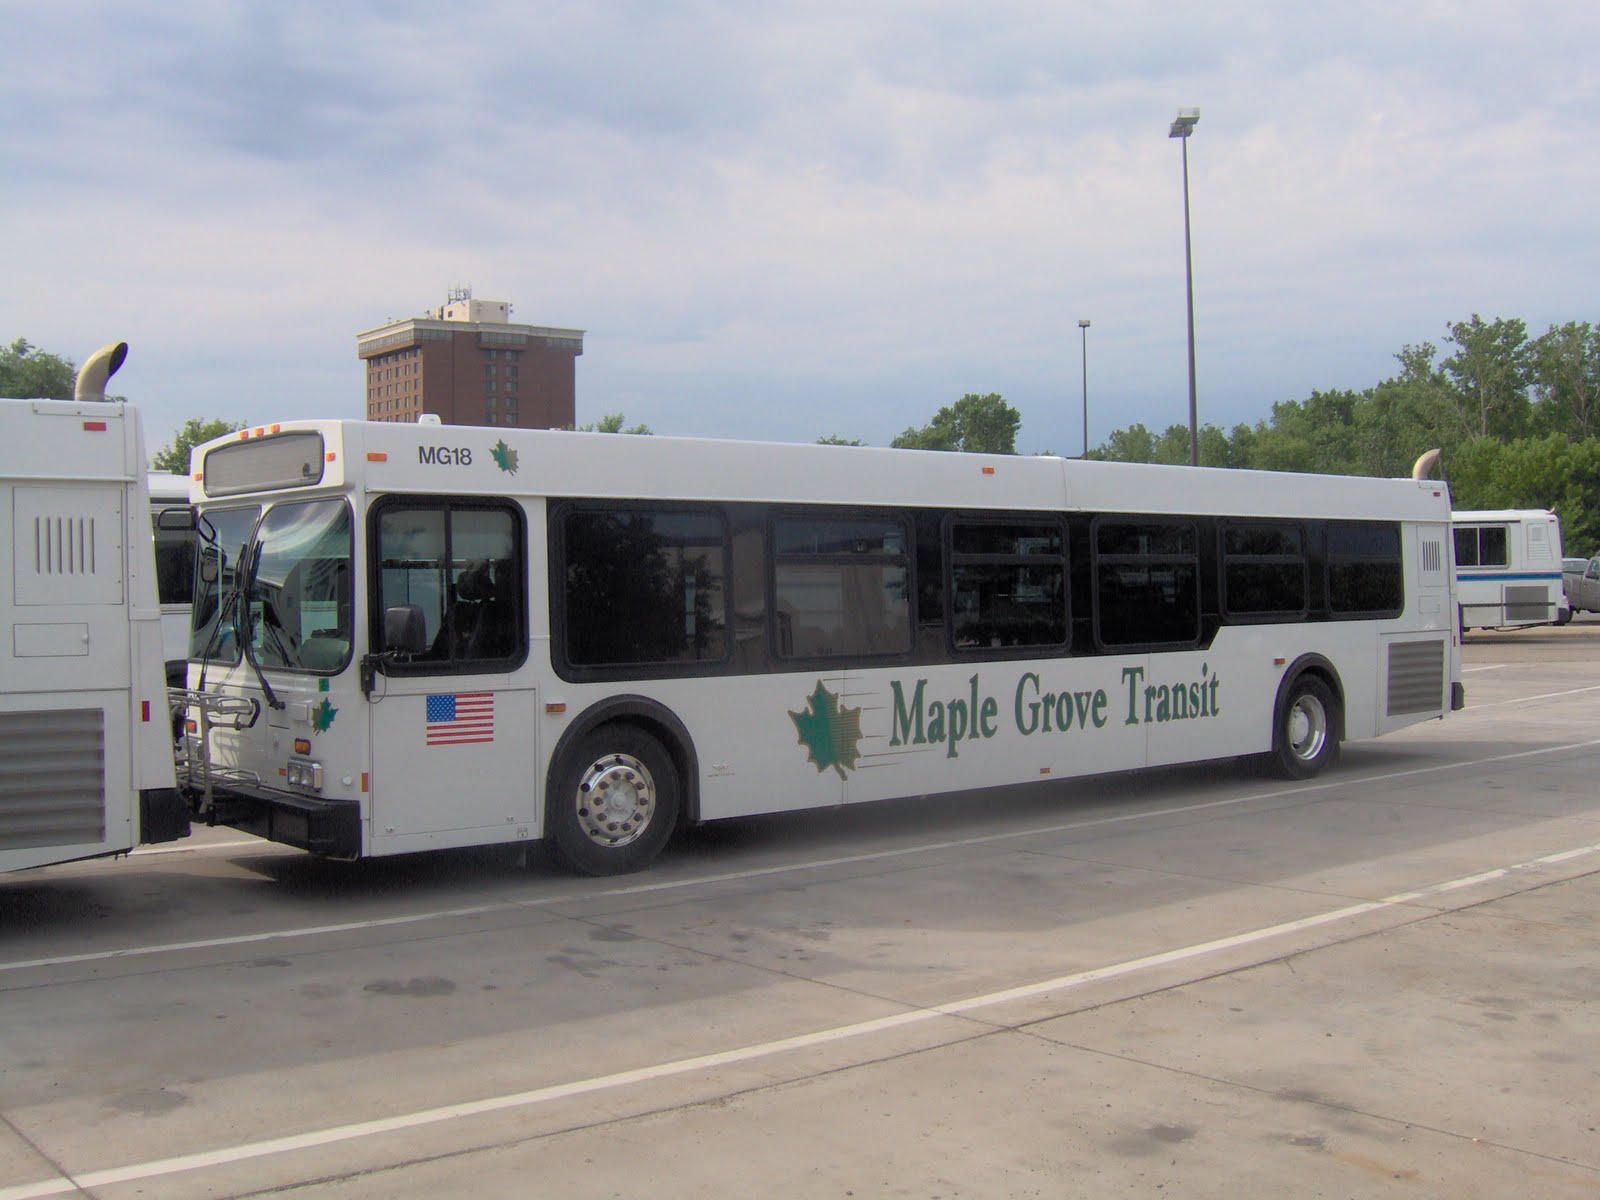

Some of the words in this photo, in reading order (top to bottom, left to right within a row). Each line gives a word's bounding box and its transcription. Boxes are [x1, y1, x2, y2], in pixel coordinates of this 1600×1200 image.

[418, 446, 472, 466] MG18
[889, 672, 998, 758] Maple
[1015, 672, 1108, 736] Grove
[1122, 662, 1220, 725] Transit
